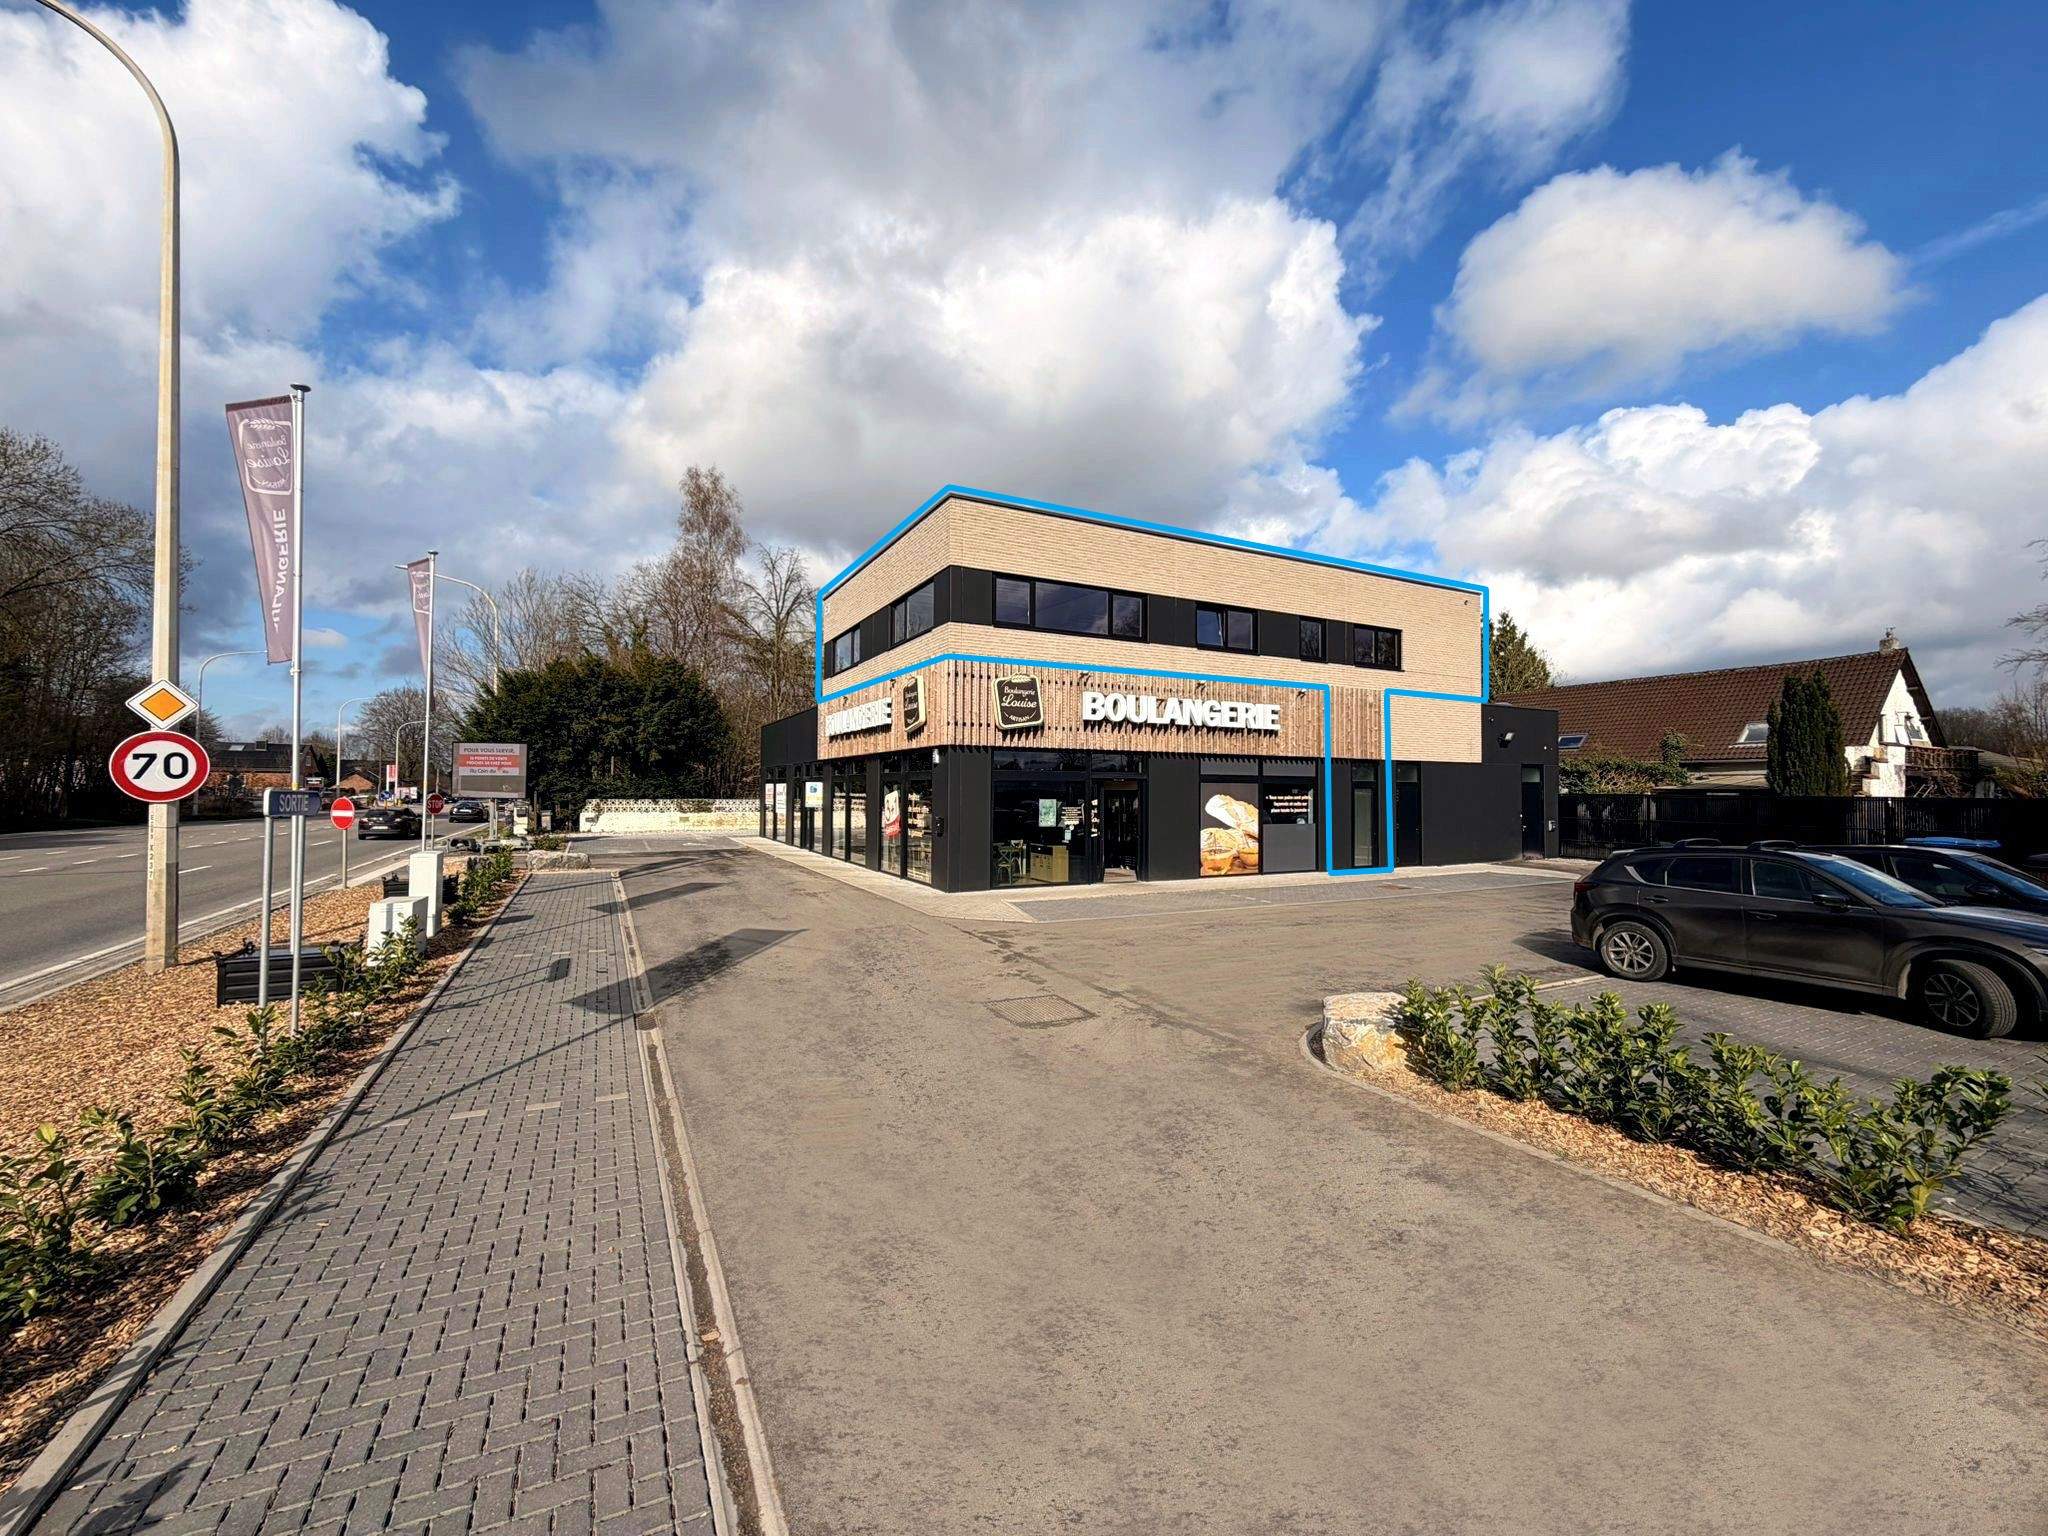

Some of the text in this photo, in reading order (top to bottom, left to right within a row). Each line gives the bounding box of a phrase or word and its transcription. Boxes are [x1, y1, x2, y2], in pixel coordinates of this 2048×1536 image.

[1004, 686, 1035, 697] Boulangerie
[1001, 694, 1037, 707] Louise
[1082, 691, 1281, 730] BOULANGERIE
[132, 752, 189, 779] 70
[279, 794, 309, 812] SORTIE
[427, 800, 443, 809] STOP
